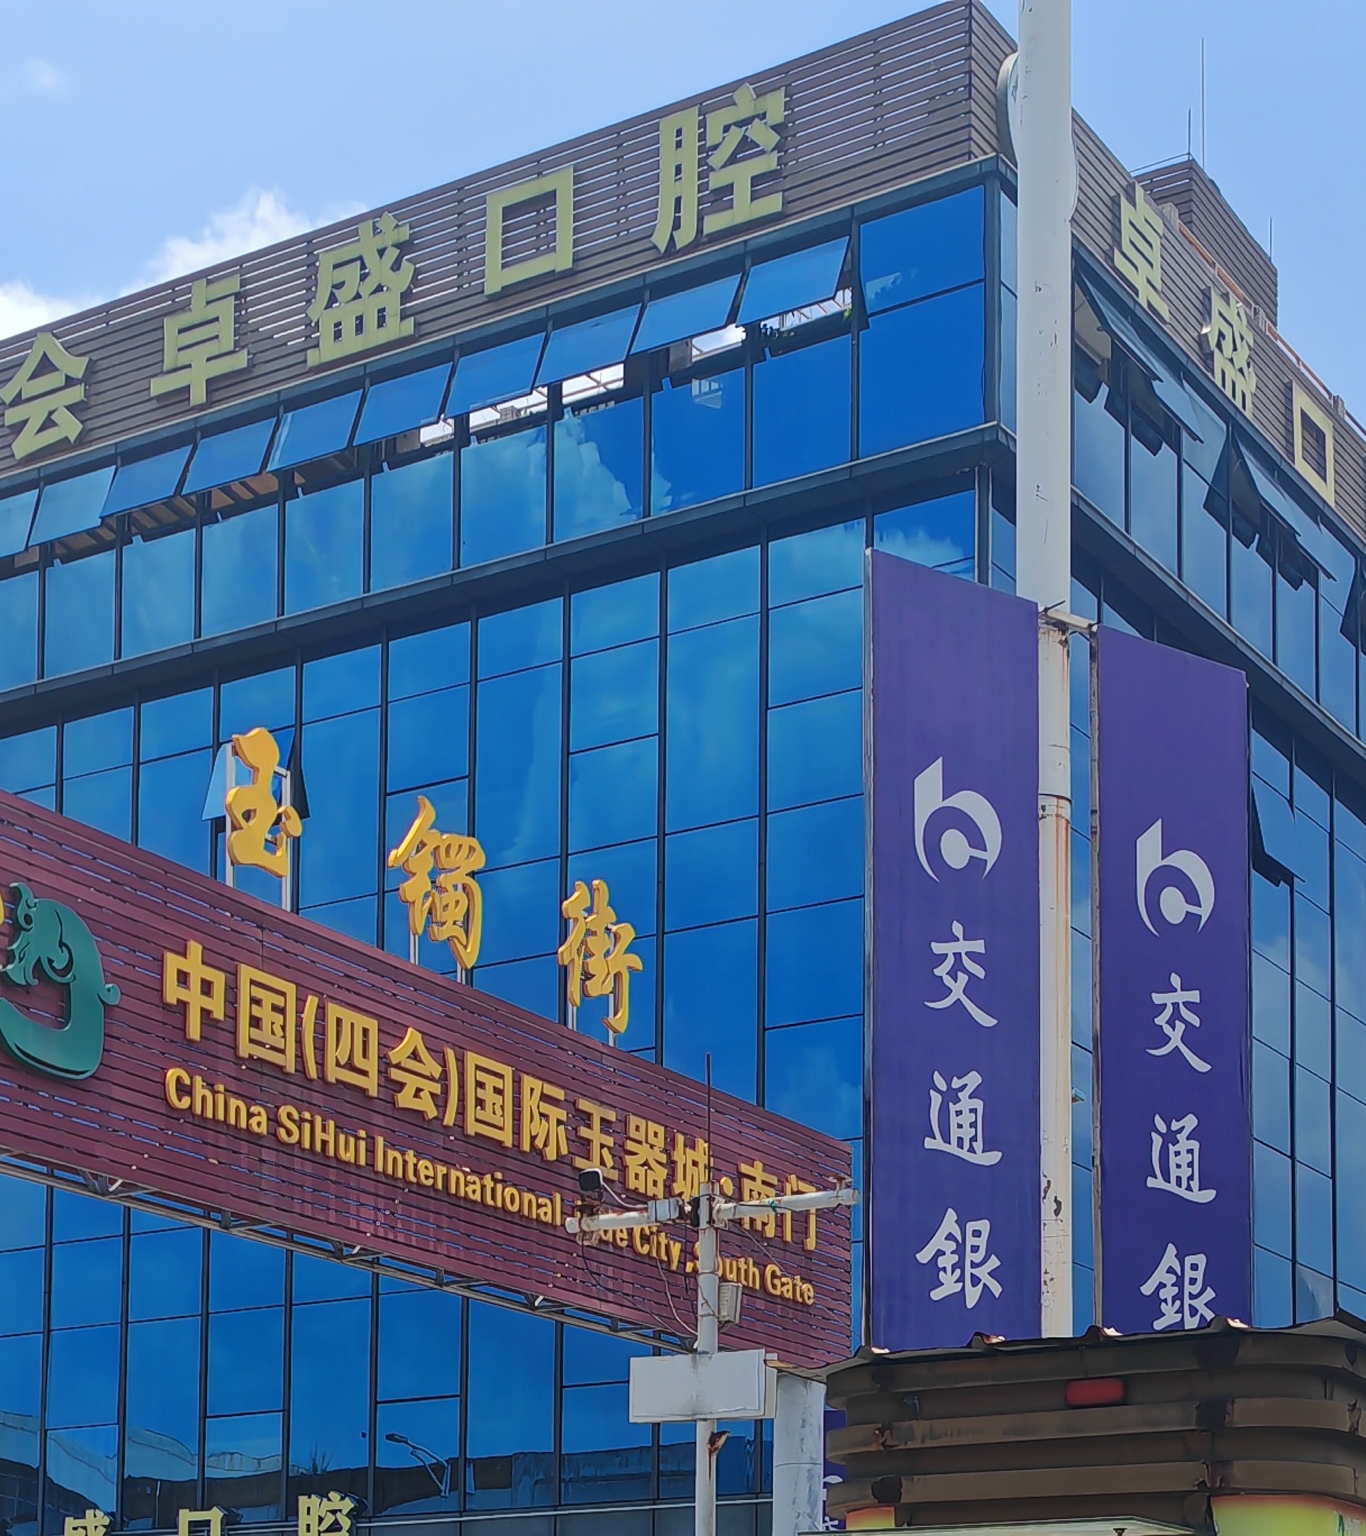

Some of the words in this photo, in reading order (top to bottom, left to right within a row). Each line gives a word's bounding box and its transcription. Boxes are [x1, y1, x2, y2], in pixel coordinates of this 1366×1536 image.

[225, 727, 643, 1034] 玉镯街
[165, 1067, 267, 1137] China
[276, 1104, 366, 1168] SiHui
[373, 1135, 562, 1227] International
[633, 1222, 682, 1273] City
[764, 1263, 816, 1306] Gate
[915, 920, 1003, 1309] 交通銀
[1139, 972, 1217, 1332] 交通銀
